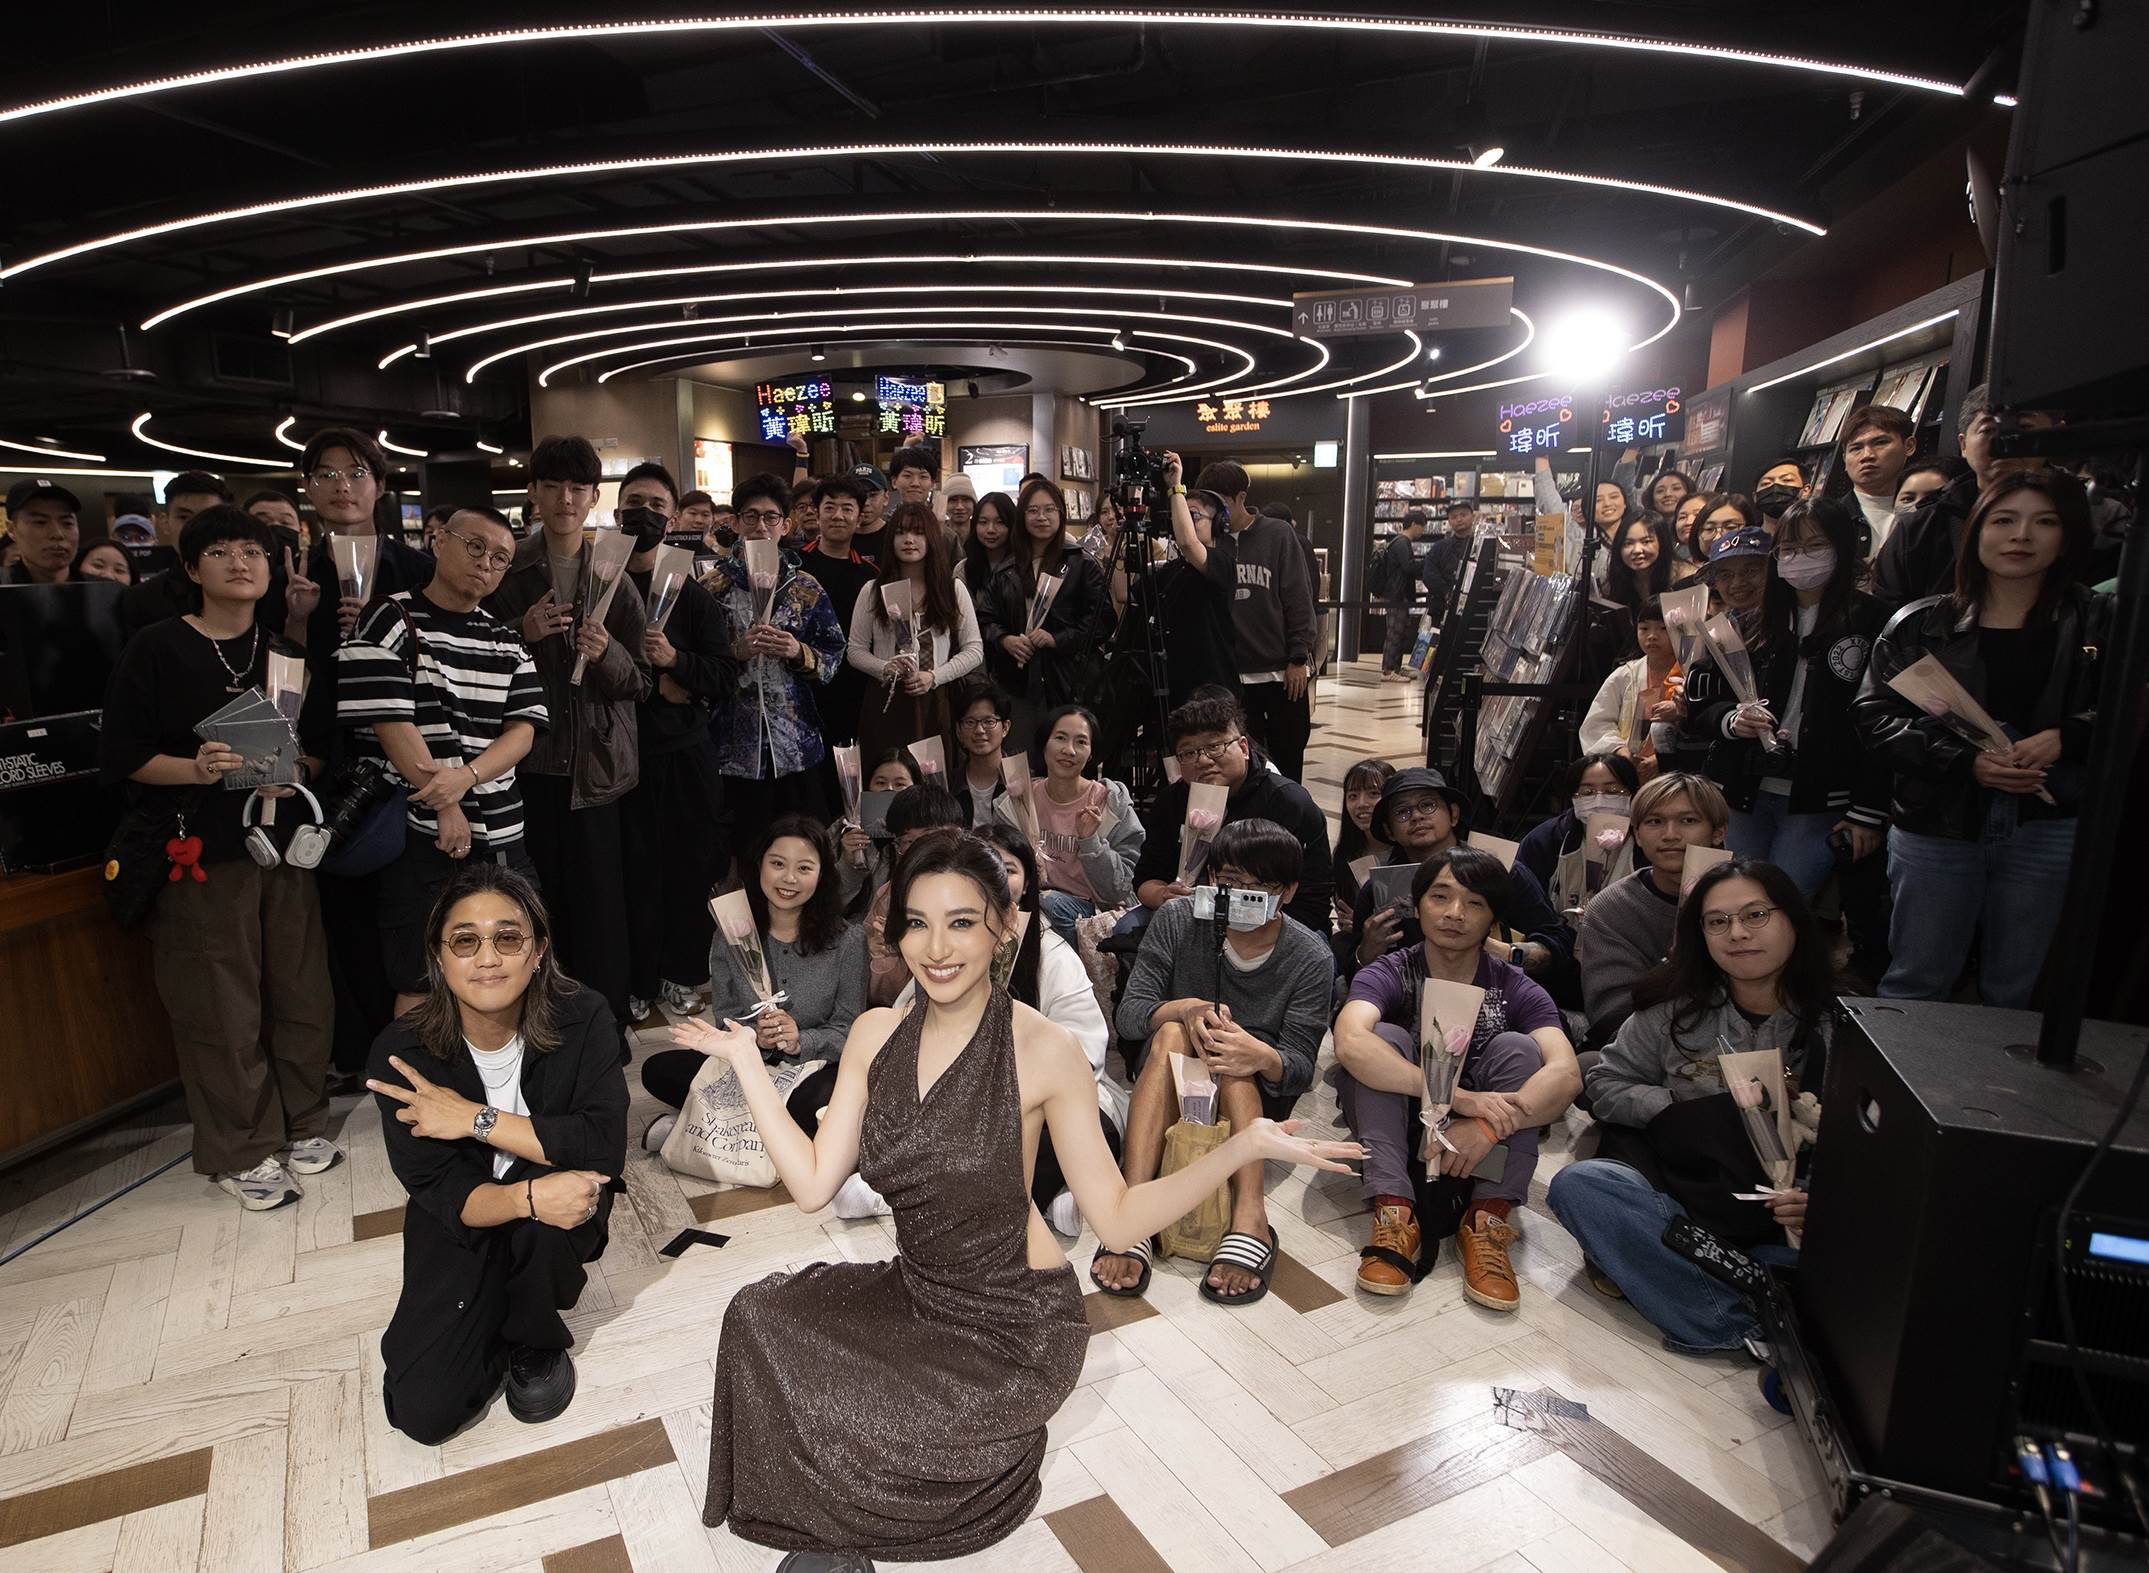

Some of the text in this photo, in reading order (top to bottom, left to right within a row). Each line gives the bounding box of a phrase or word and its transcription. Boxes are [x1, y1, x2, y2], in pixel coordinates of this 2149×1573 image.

[756, 382, 831, 405] Haezee
[879, 377, 927, 402] Haezee
[1500, 395, 1572, 420] Haezee
[1206, 421, 1260, 433] eslite garden
[1509, 421, 1560, 453] 瑋昕
[1607, 412, 1666, 443] 瑋昕
[0, 768, 26, 784] ORD
[26, 761, 66, 779] SLEEVES
[685, 1123, 717, 1141] and
